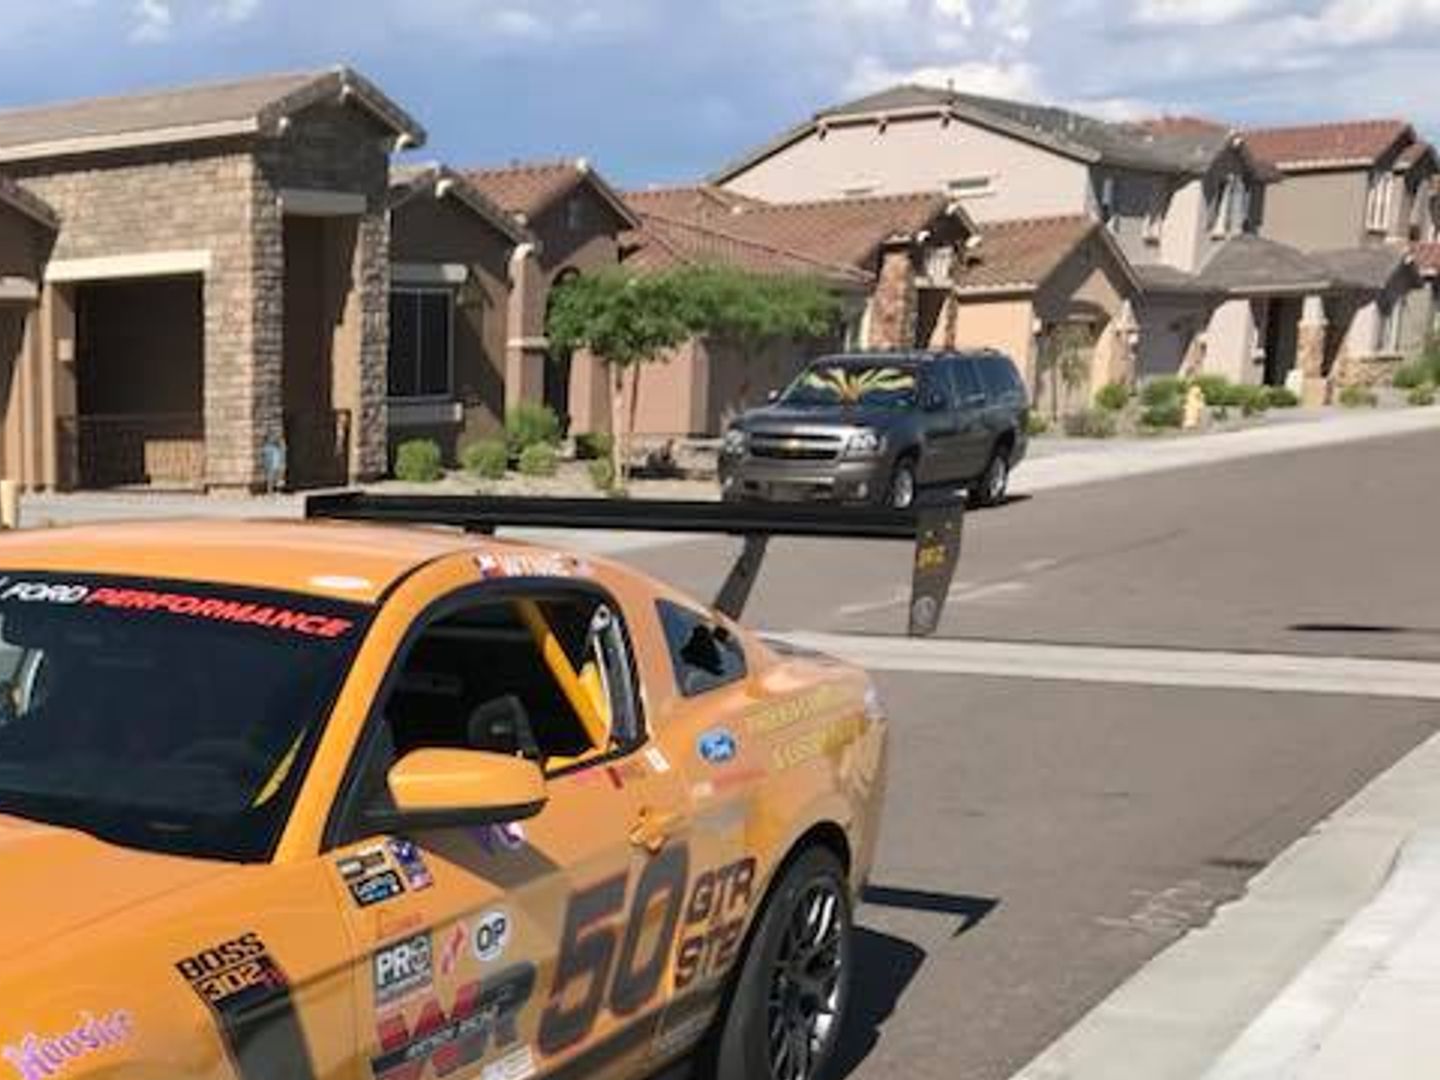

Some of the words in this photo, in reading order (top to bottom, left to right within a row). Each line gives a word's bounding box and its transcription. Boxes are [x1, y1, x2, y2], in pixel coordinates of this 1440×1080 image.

[1, 581, 88, 603] FORD
[84, 587, 354, 638] PERFORMANCE
[175, 932, 265, 980] BOSS
[477, 917, 507, 952] OP
[538, 838, 690, 1057] 50
[199, 961, 262, 1000] 302
